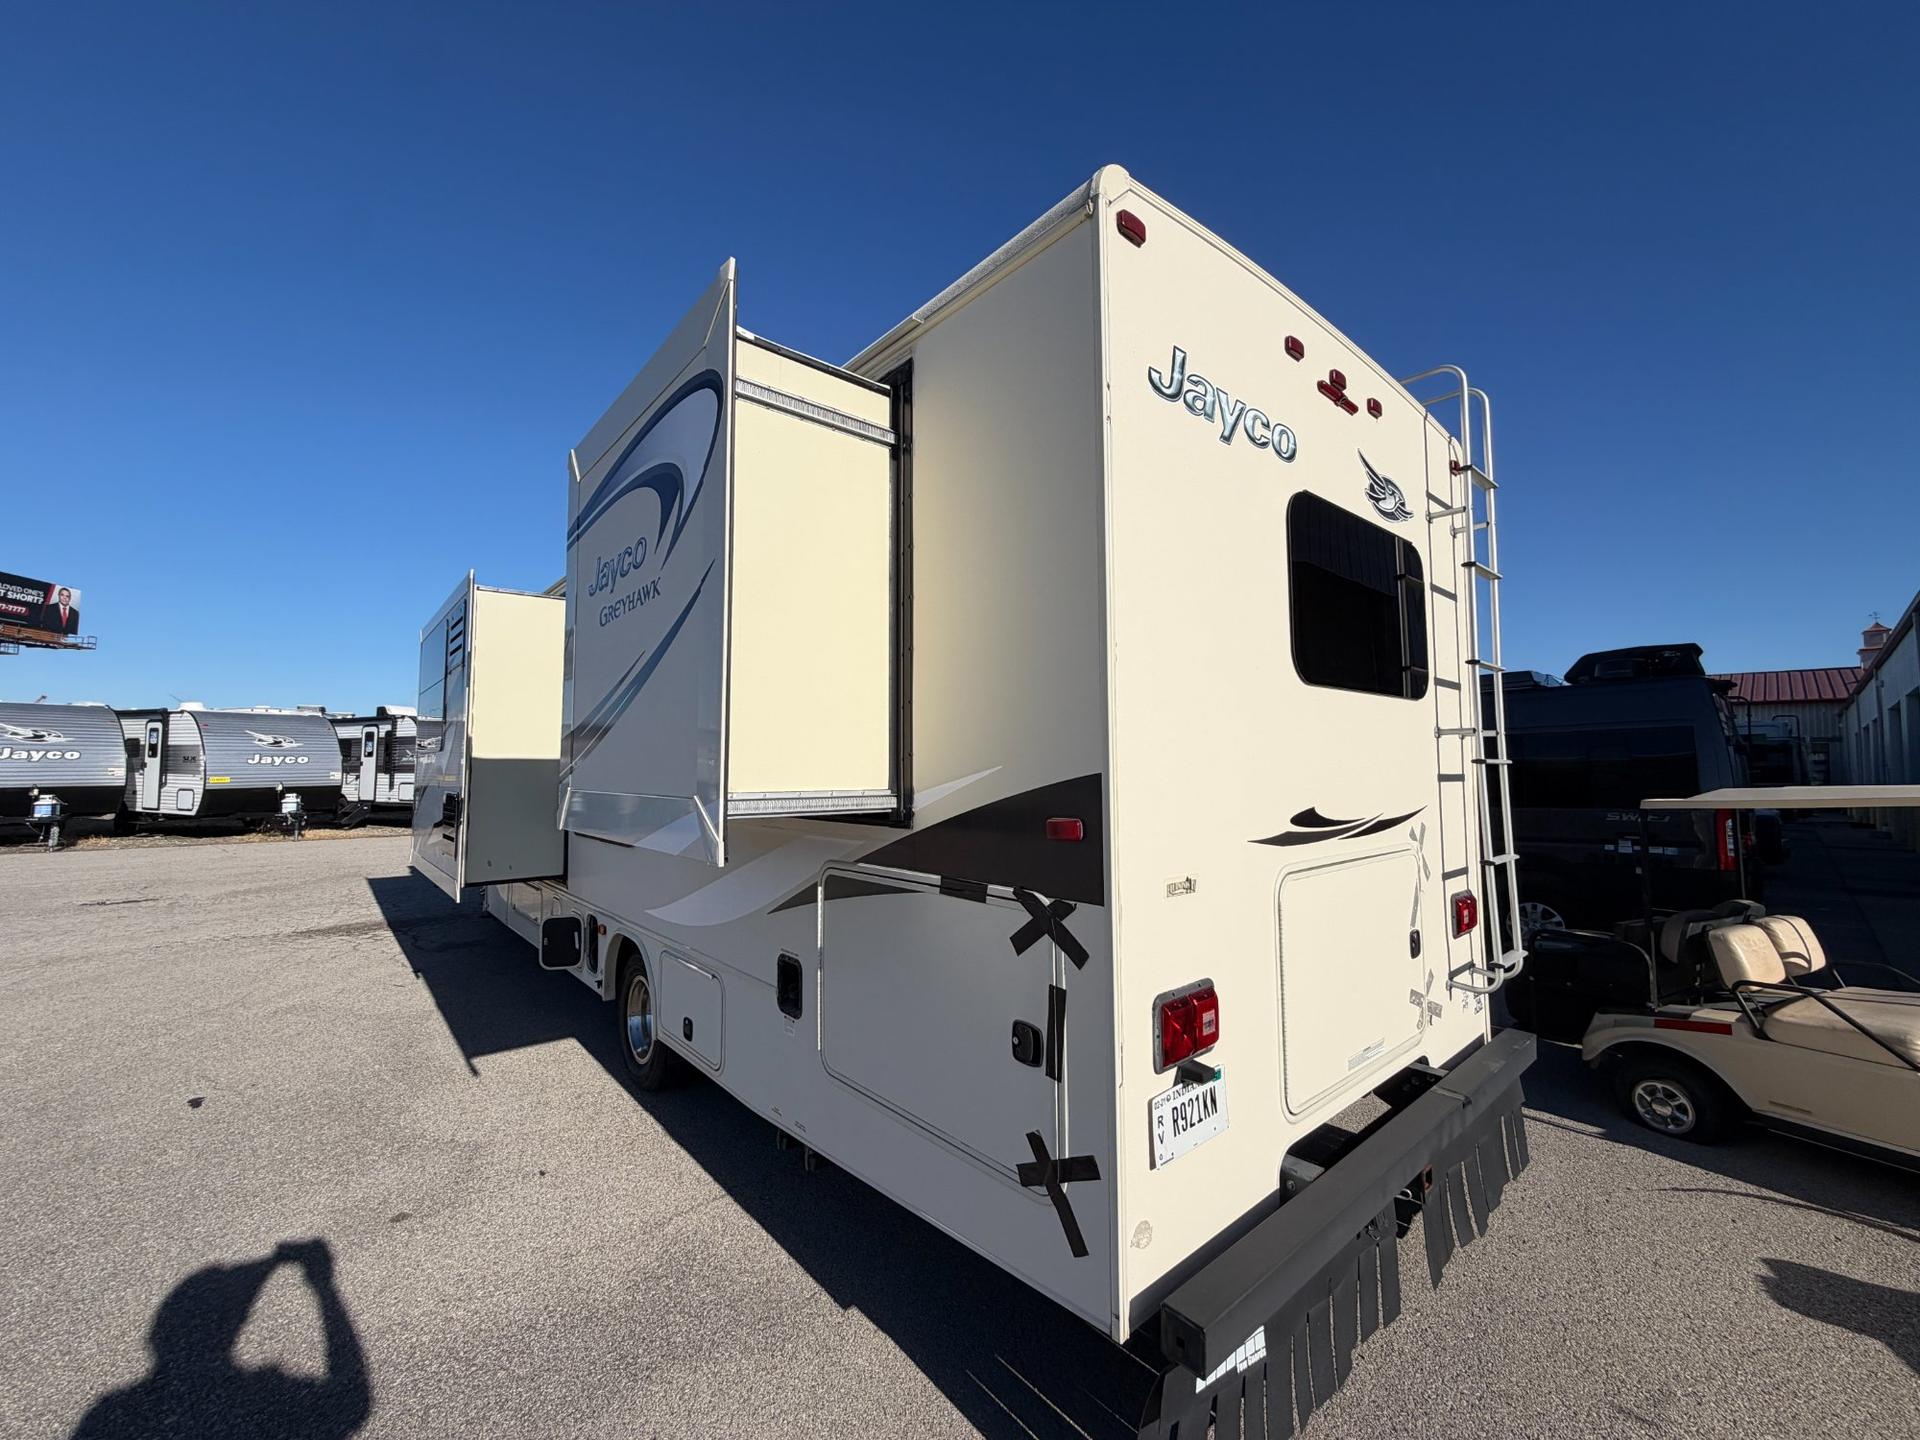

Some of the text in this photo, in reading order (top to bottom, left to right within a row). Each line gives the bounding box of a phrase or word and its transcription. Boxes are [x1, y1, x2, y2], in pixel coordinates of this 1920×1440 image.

[1147, 344, 1298, 464] Jayco
[587, 536, 648, 598] Jayco
[599, 576, 662, 628] GREYHAWK
[0, 747, 81, 762] Jayco
[247, 754, 309, 766] Jayco
[1171, 1085, 1218, 1138] R921KN
